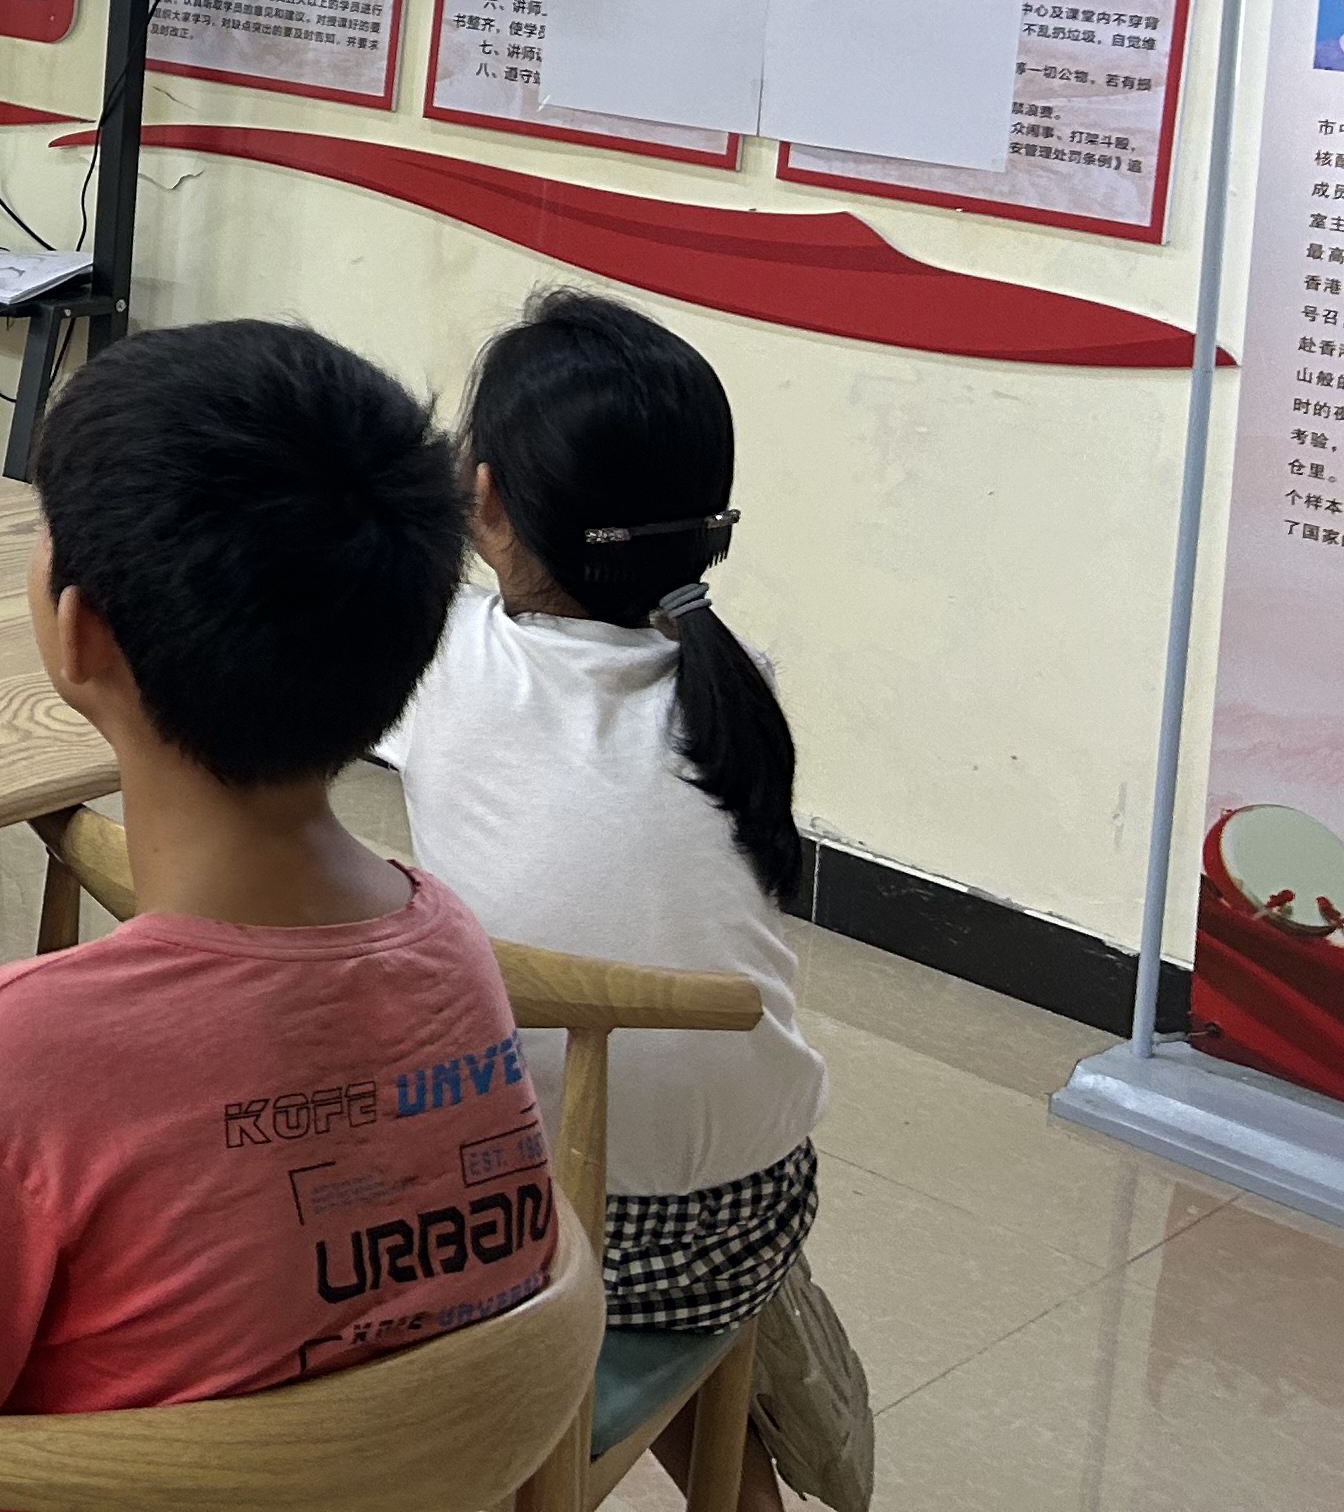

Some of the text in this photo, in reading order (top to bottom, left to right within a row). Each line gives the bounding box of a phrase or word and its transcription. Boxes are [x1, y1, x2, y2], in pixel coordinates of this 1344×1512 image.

[1304, 275, 1342, 295] 香港
[1298, 336, 1344, 357] 赴香
[1290, 428, 1338, 453] 考验，
[1288, 458, 1337, 483] 仓里。
[1285, 489, 1343, 514] 个样本
[1284, 519, 1344, 547] 了国家
